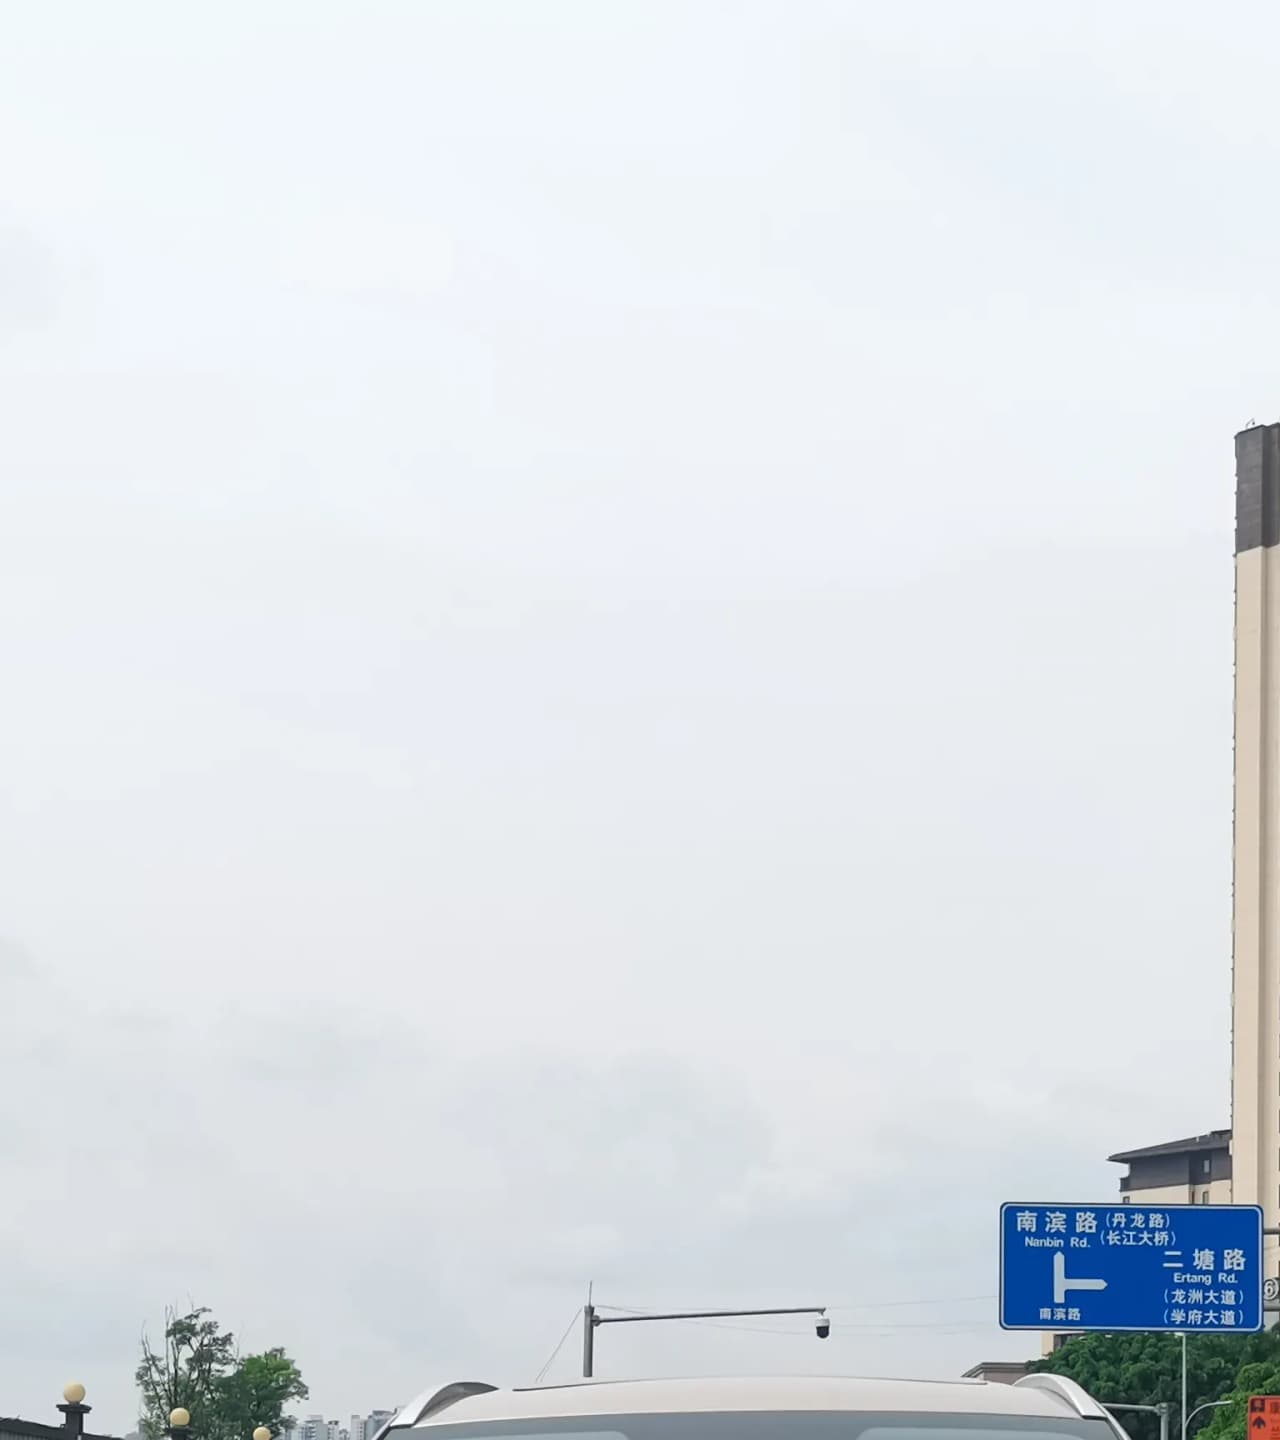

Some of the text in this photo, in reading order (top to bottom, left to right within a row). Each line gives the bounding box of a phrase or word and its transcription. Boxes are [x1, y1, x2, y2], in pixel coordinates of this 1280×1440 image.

[1016, 1210, 1098, 1233] 南滨路
[1105, 1212, 1171, 1229] (丹龙路)
[1024, 1236, 1091, 1248] Nanbin Rd.
[1099, 1230, 1177, 1247] (长江大桥)
[1162, 1248, 1246, 1271] 二塘路
[1173, 1272, 1238, 1285] Ertang Rd.
[1163, 1288, 1244, 1305] (龙洲大道)
[1039, 1307, 1081, 1321] 南滨路
[1163, 1309, 1244, 1326] (学府大道)
